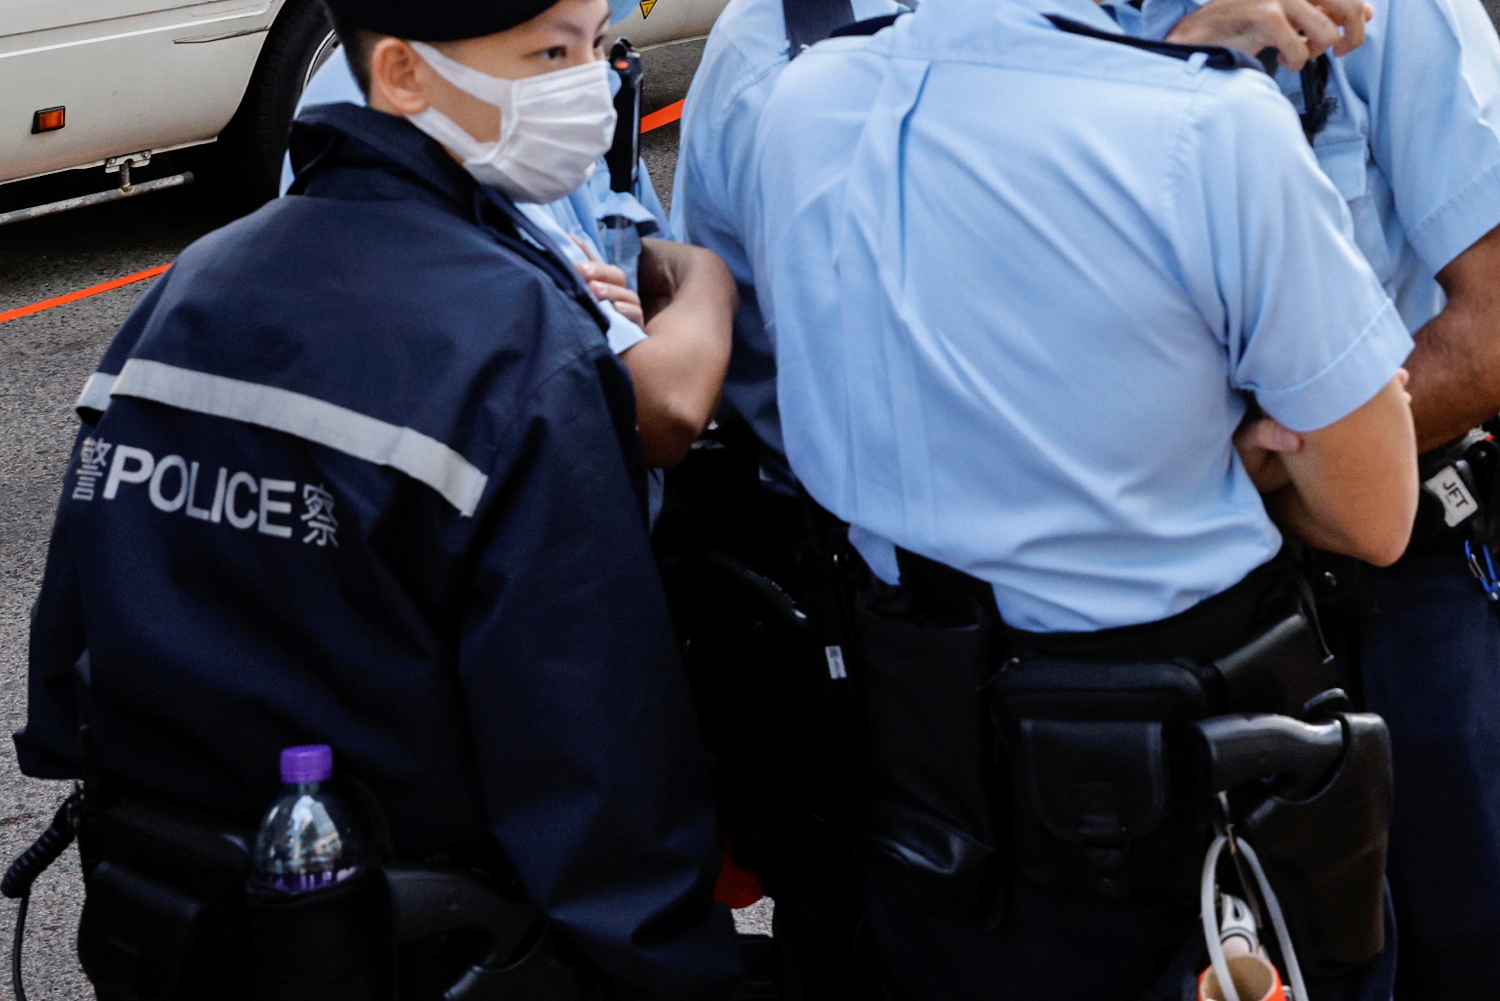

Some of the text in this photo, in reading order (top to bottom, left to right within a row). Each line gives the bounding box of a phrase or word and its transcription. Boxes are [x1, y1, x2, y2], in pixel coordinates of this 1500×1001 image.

[72, 437, 339, 548] 警 POLICE 察
[1443, 481, 1469, 508] JFT
